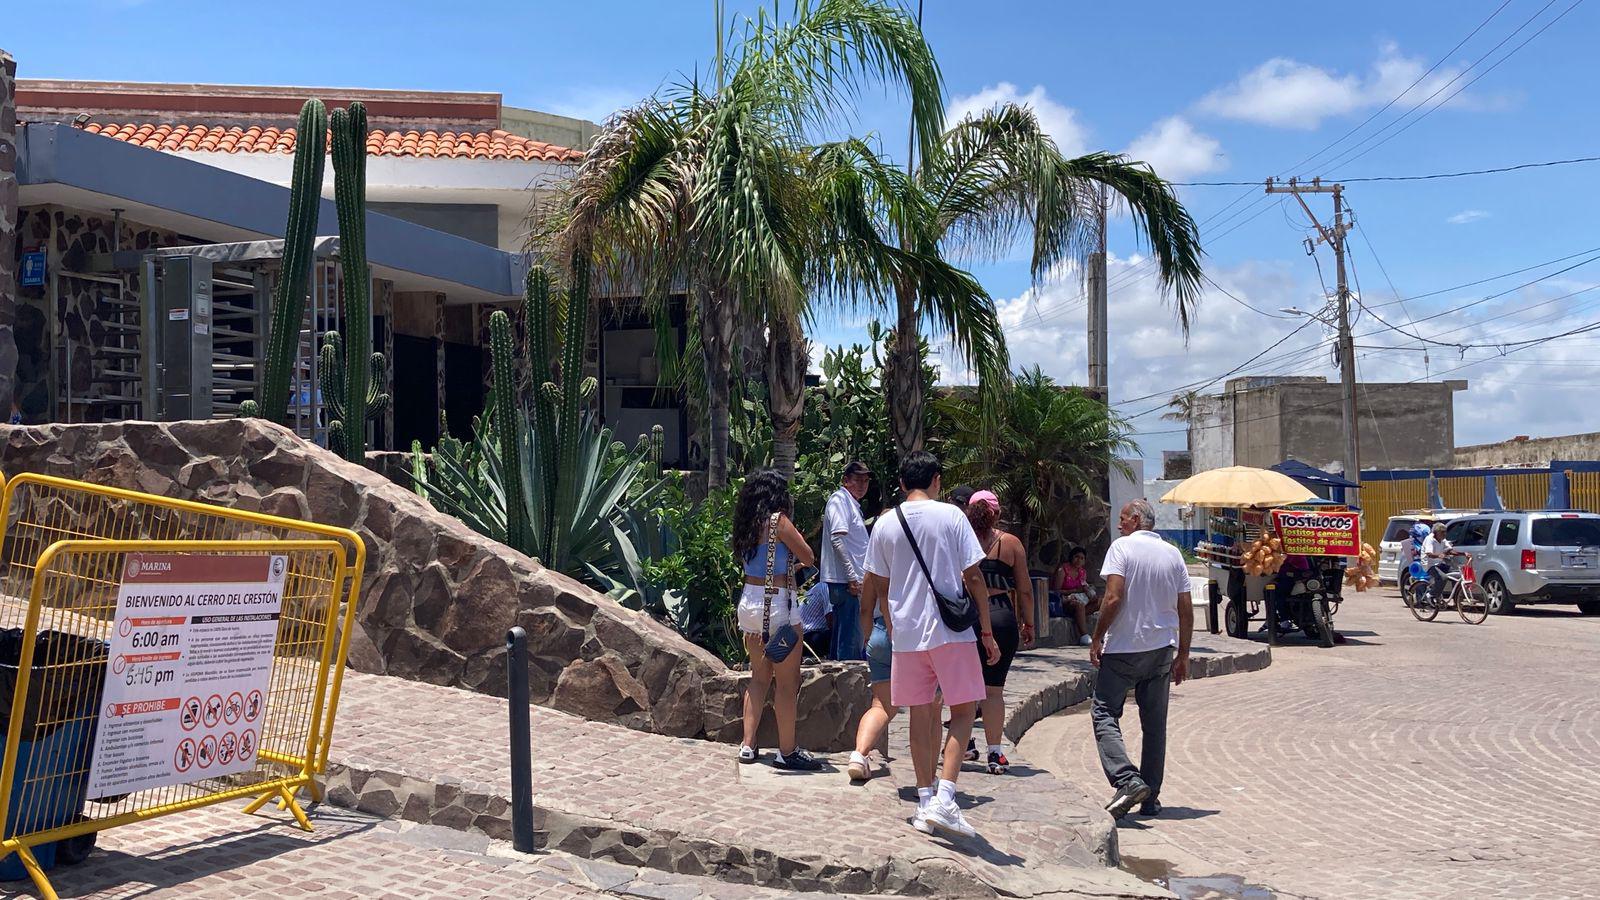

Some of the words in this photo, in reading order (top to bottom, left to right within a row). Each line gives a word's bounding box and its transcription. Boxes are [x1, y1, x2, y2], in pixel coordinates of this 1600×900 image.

[1283, 528, 1315, 537] Tostitos
[1284, 536, 1316, 545] Tostitos
[141, 562, 172, 571] MARINA
[126, 594, 182, 608] BIENVENIDO
[184, 594, 195, 606] AL
[197, 593, 226, 606] CERRO
[227, 593, 242, 605] DEL
[244, 591, 278, 604] CRESTÓN
[132, 631, 159, 648] 6:00
[160, 633, 179, 646] am
[154, 669, 174, 686] pm
[122, 704, 132, 715] SE
[133, 700, 166, 713] PROHIBE
